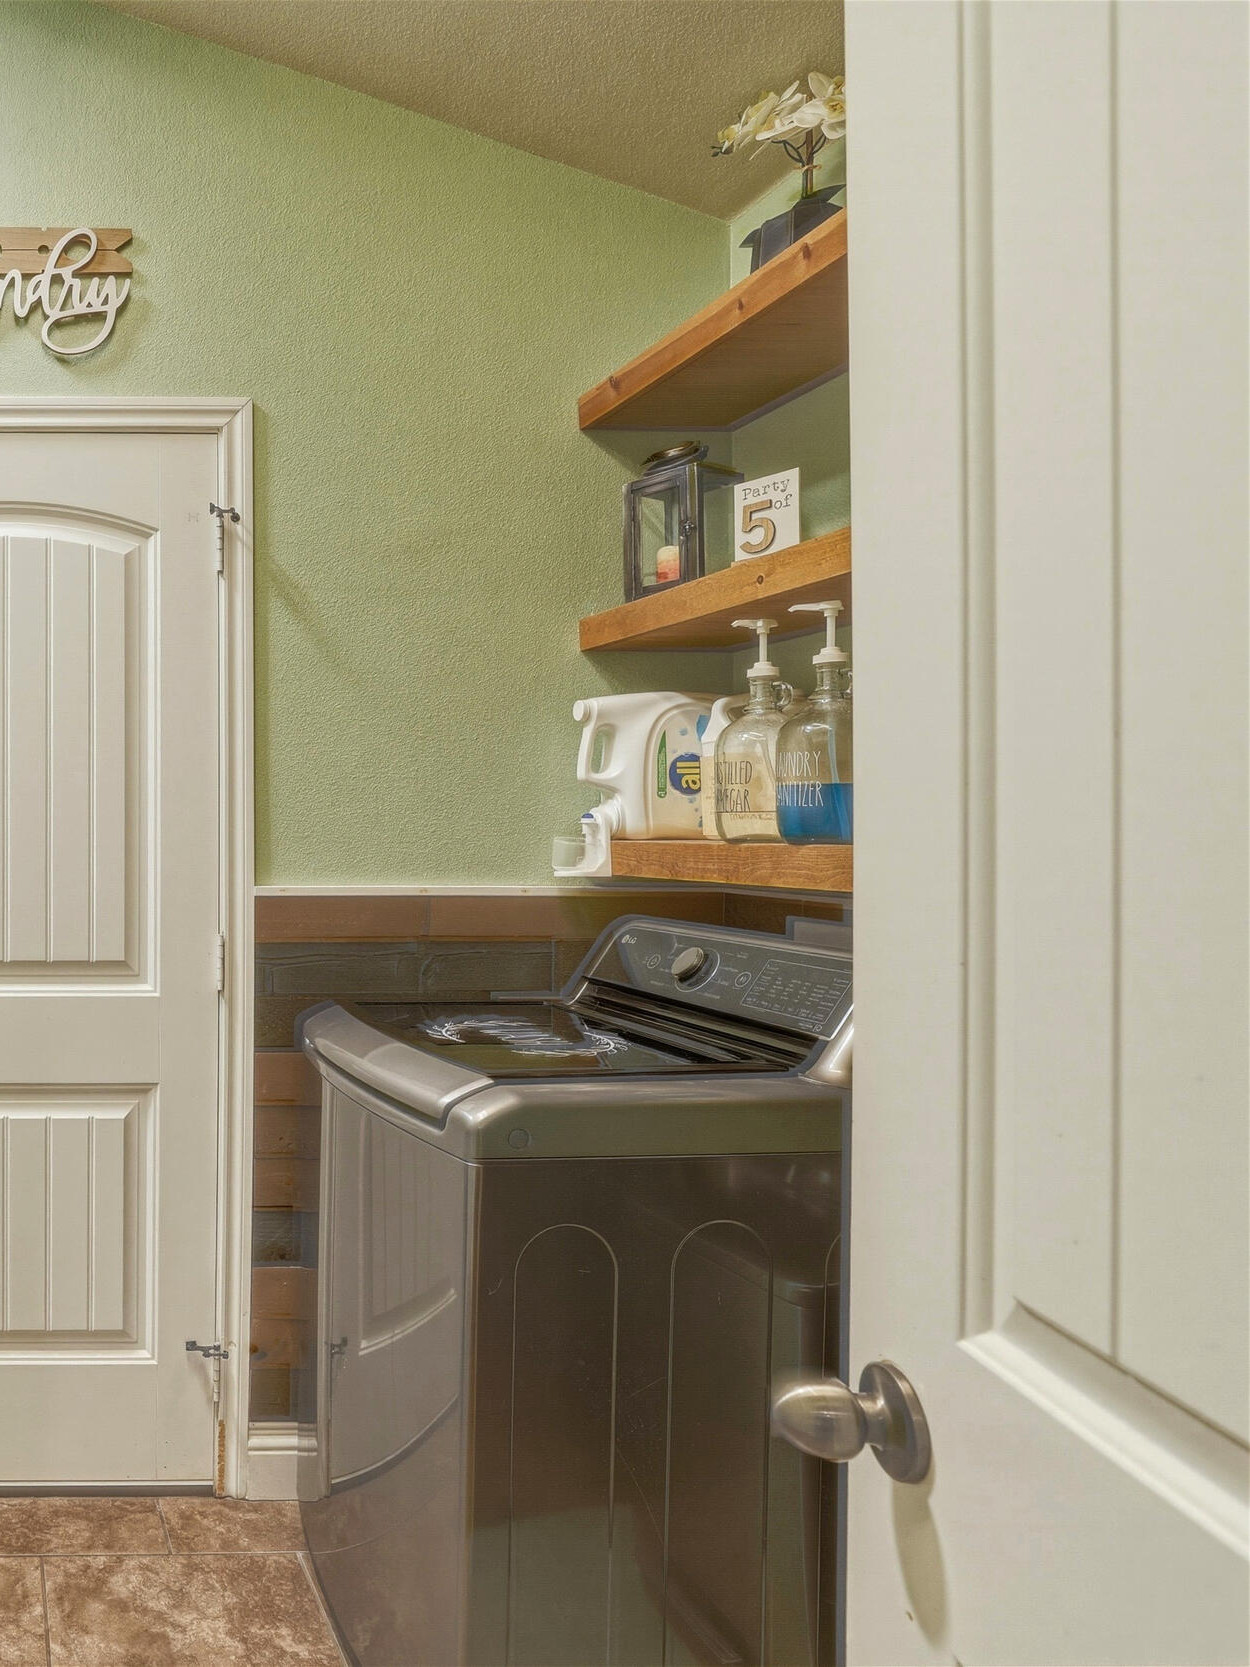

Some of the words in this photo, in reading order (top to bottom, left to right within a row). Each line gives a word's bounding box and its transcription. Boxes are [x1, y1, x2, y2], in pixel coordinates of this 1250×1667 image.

[742, 479, 790, 500] Party
[774, 494, 792, 510] of
[739, 499, 776, 554] 5
[676, 761, 701, 790] all
[717, 760, 753, 785] ISTILLED
[777, 781, 824, 807] ANITIZER
